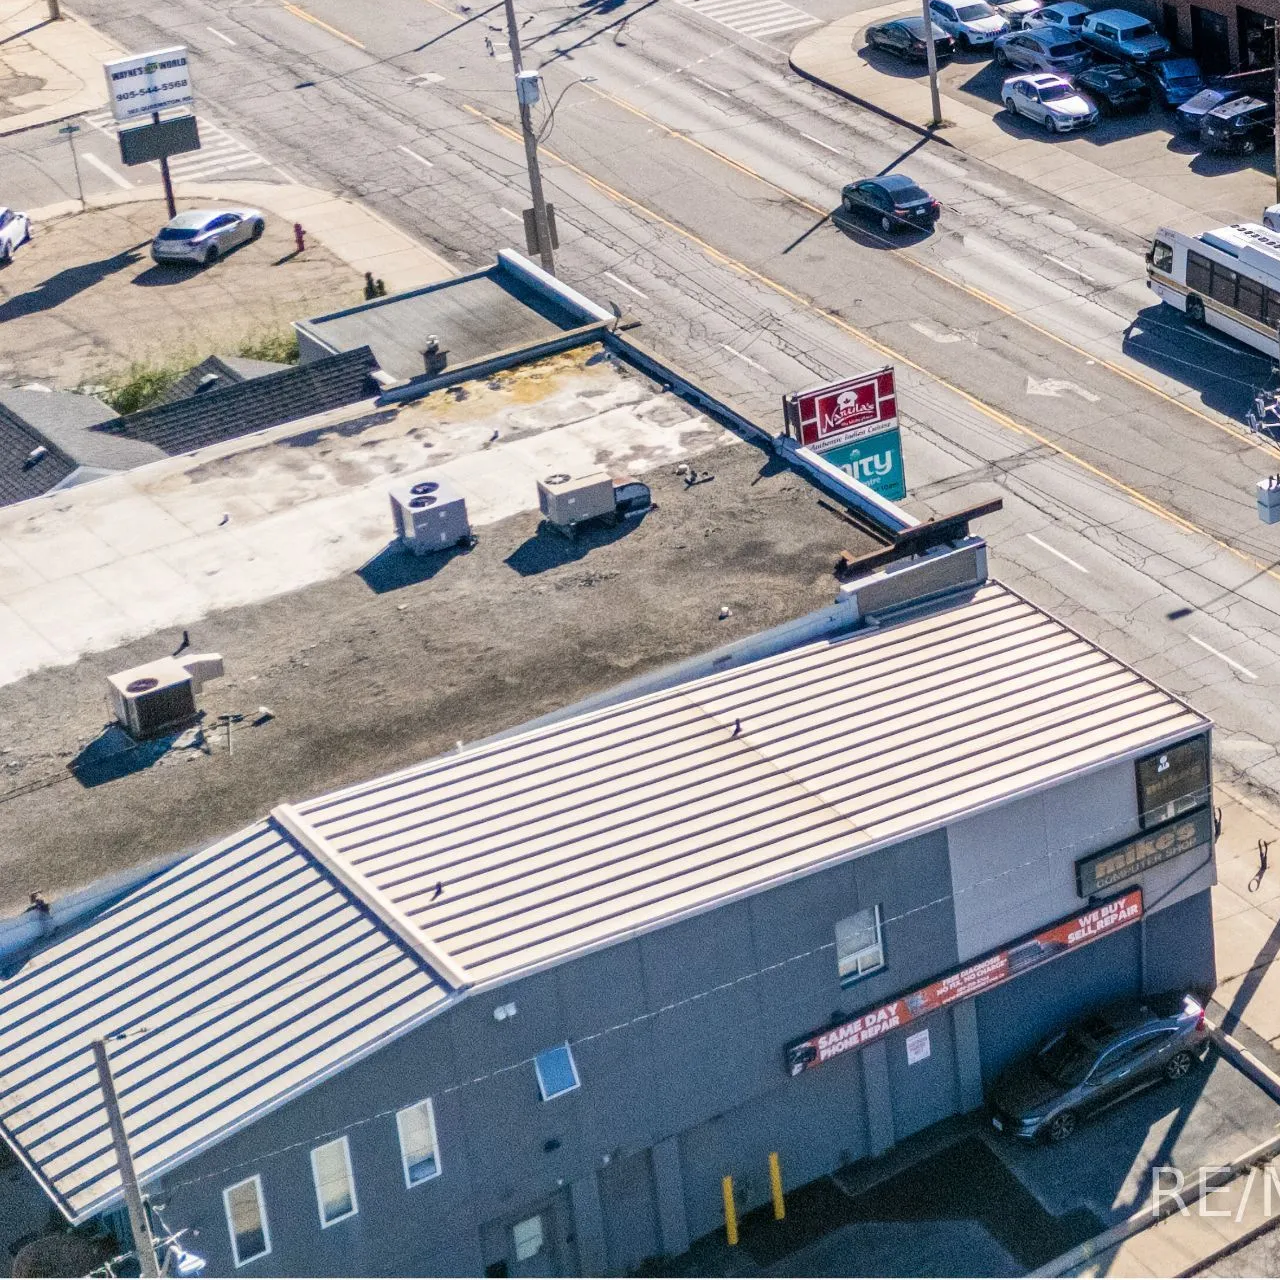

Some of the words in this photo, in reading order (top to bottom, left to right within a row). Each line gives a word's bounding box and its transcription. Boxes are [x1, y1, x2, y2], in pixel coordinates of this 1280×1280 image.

[159, 57, 186, 70] WORLD
[811, 437, 843, 451] Authentic
[844, 430, 866, 441] Indian
[867, 422, 891, 433] Cuisine
[1095, 822, 1195, 880] mike's
[1096, 852, 1163, 888] COMPUTER
[1165, 837, 1196, 858] SHOP
[1078, 910, 1099, 928] WE
[1100, 898, 1126, 918] BUY
[1096, 904, 1139, 930] REPAIR
[936, 987, 949, 996] NO
[963, 973, 976, 983] NO
[942, 974, 960, 987] FREE
[960, 955, 1001, 978] DIAGNOSIS
[817, 1018, 863, 1049] SAME
[864, 1003, 899, 1028] DAY
[819, 1034, 860, 1061] PHONE
[860, 1015, 900, 1041] REPAIR
